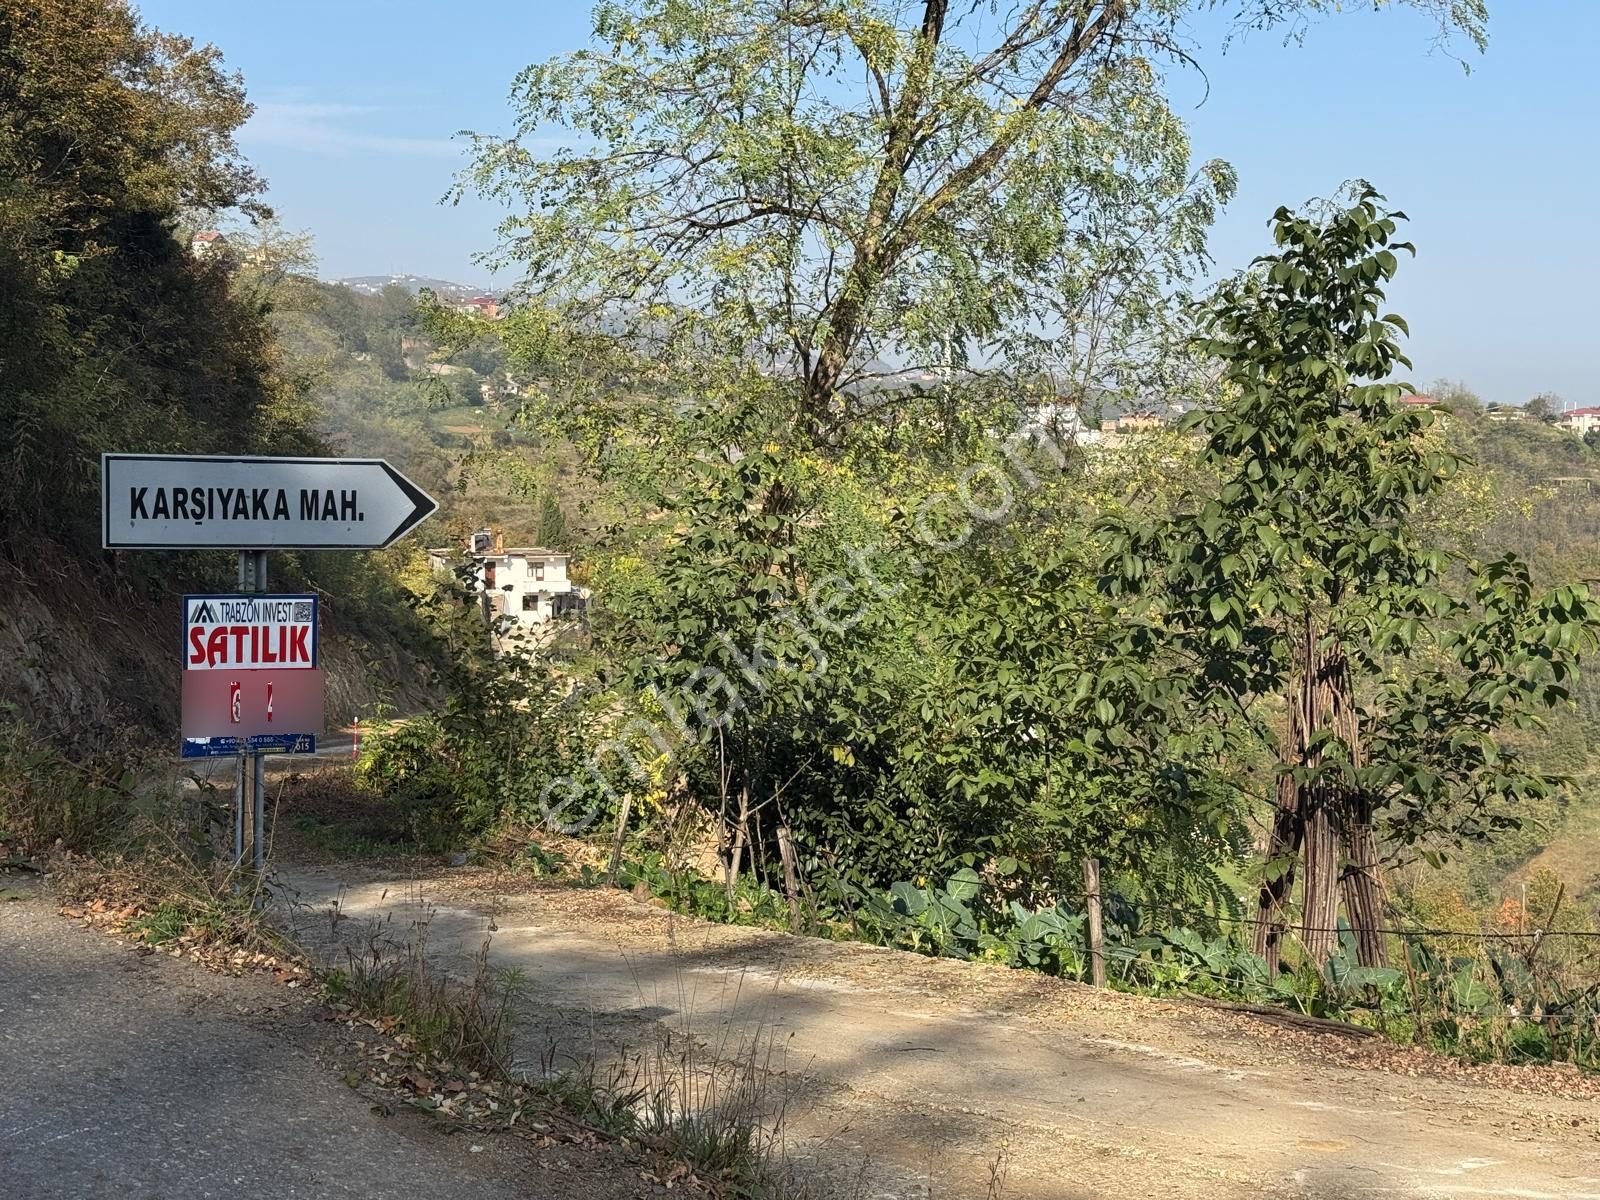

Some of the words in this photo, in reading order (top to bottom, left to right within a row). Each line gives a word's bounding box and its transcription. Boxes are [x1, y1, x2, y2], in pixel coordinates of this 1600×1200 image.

[130, 486, 290, 526] KARŞIYAKA
[300, 489, 365, 522] MAH.
[220, 602, 260, 623] TRABZON
[262, 602, 293, 623] INVEST
[189, 625, 310, 669] SATILIK
